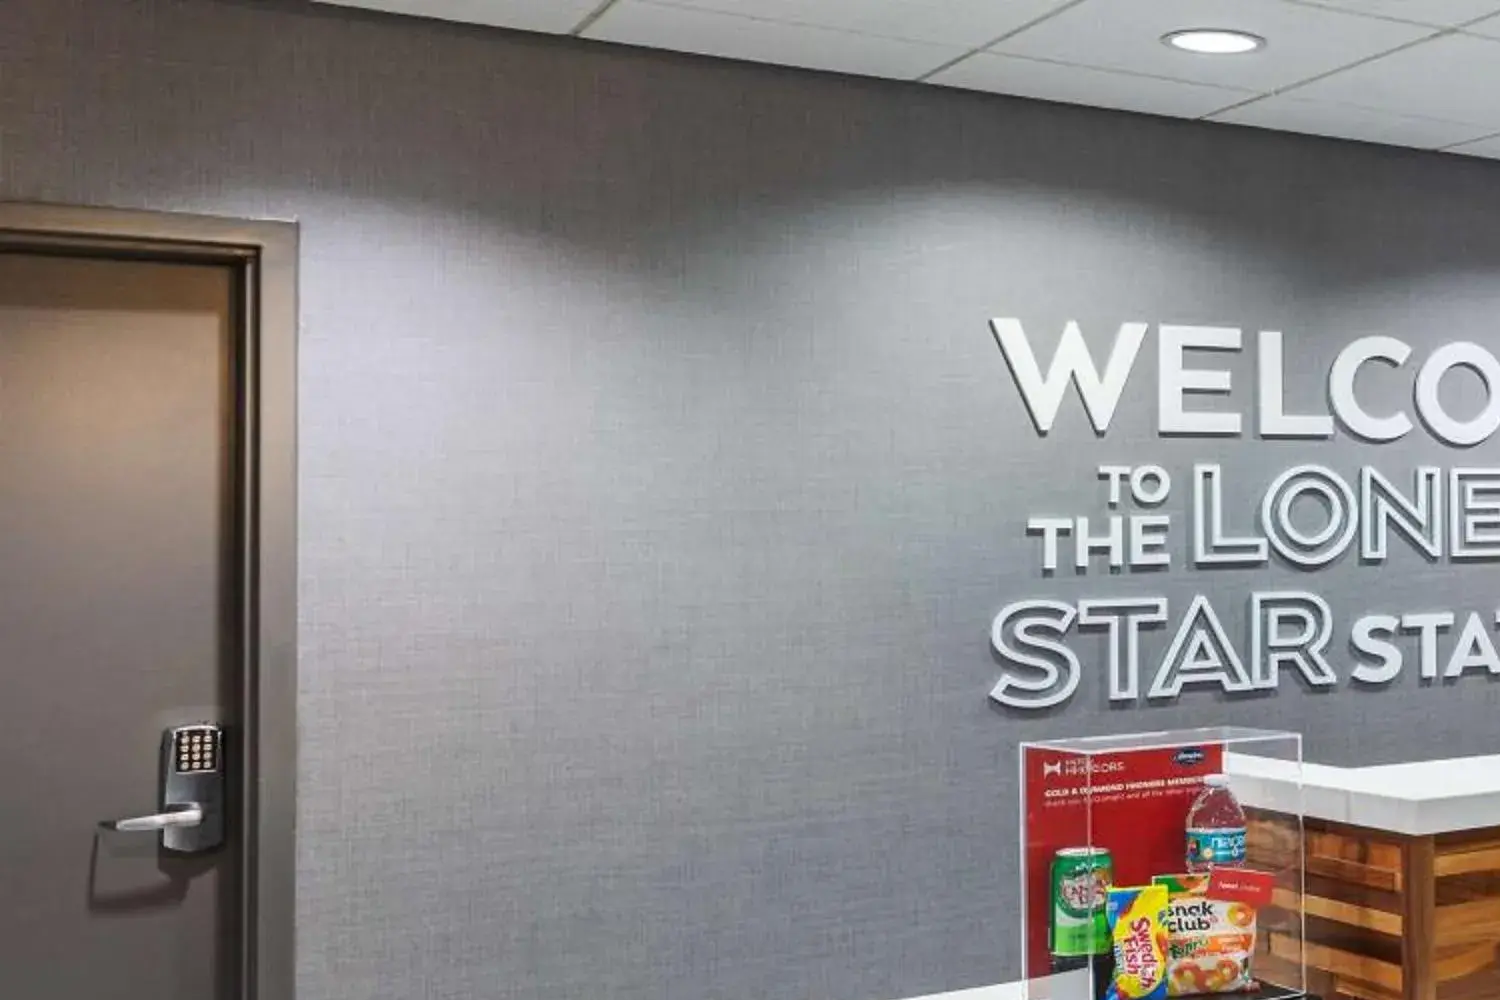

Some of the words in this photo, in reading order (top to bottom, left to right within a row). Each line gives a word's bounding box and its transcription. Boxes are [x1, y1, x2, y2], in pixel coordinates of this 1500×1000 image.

[1098, 465, 1171, 505] TO
[1027, 515, 1171, 570] THE
[989, 591, 1337, 709] STAR
[1167, 918, 1211, 933] club
[1124, 936, 1141, 975] Fish
[1132, 917, 1158, 989] Swedish
